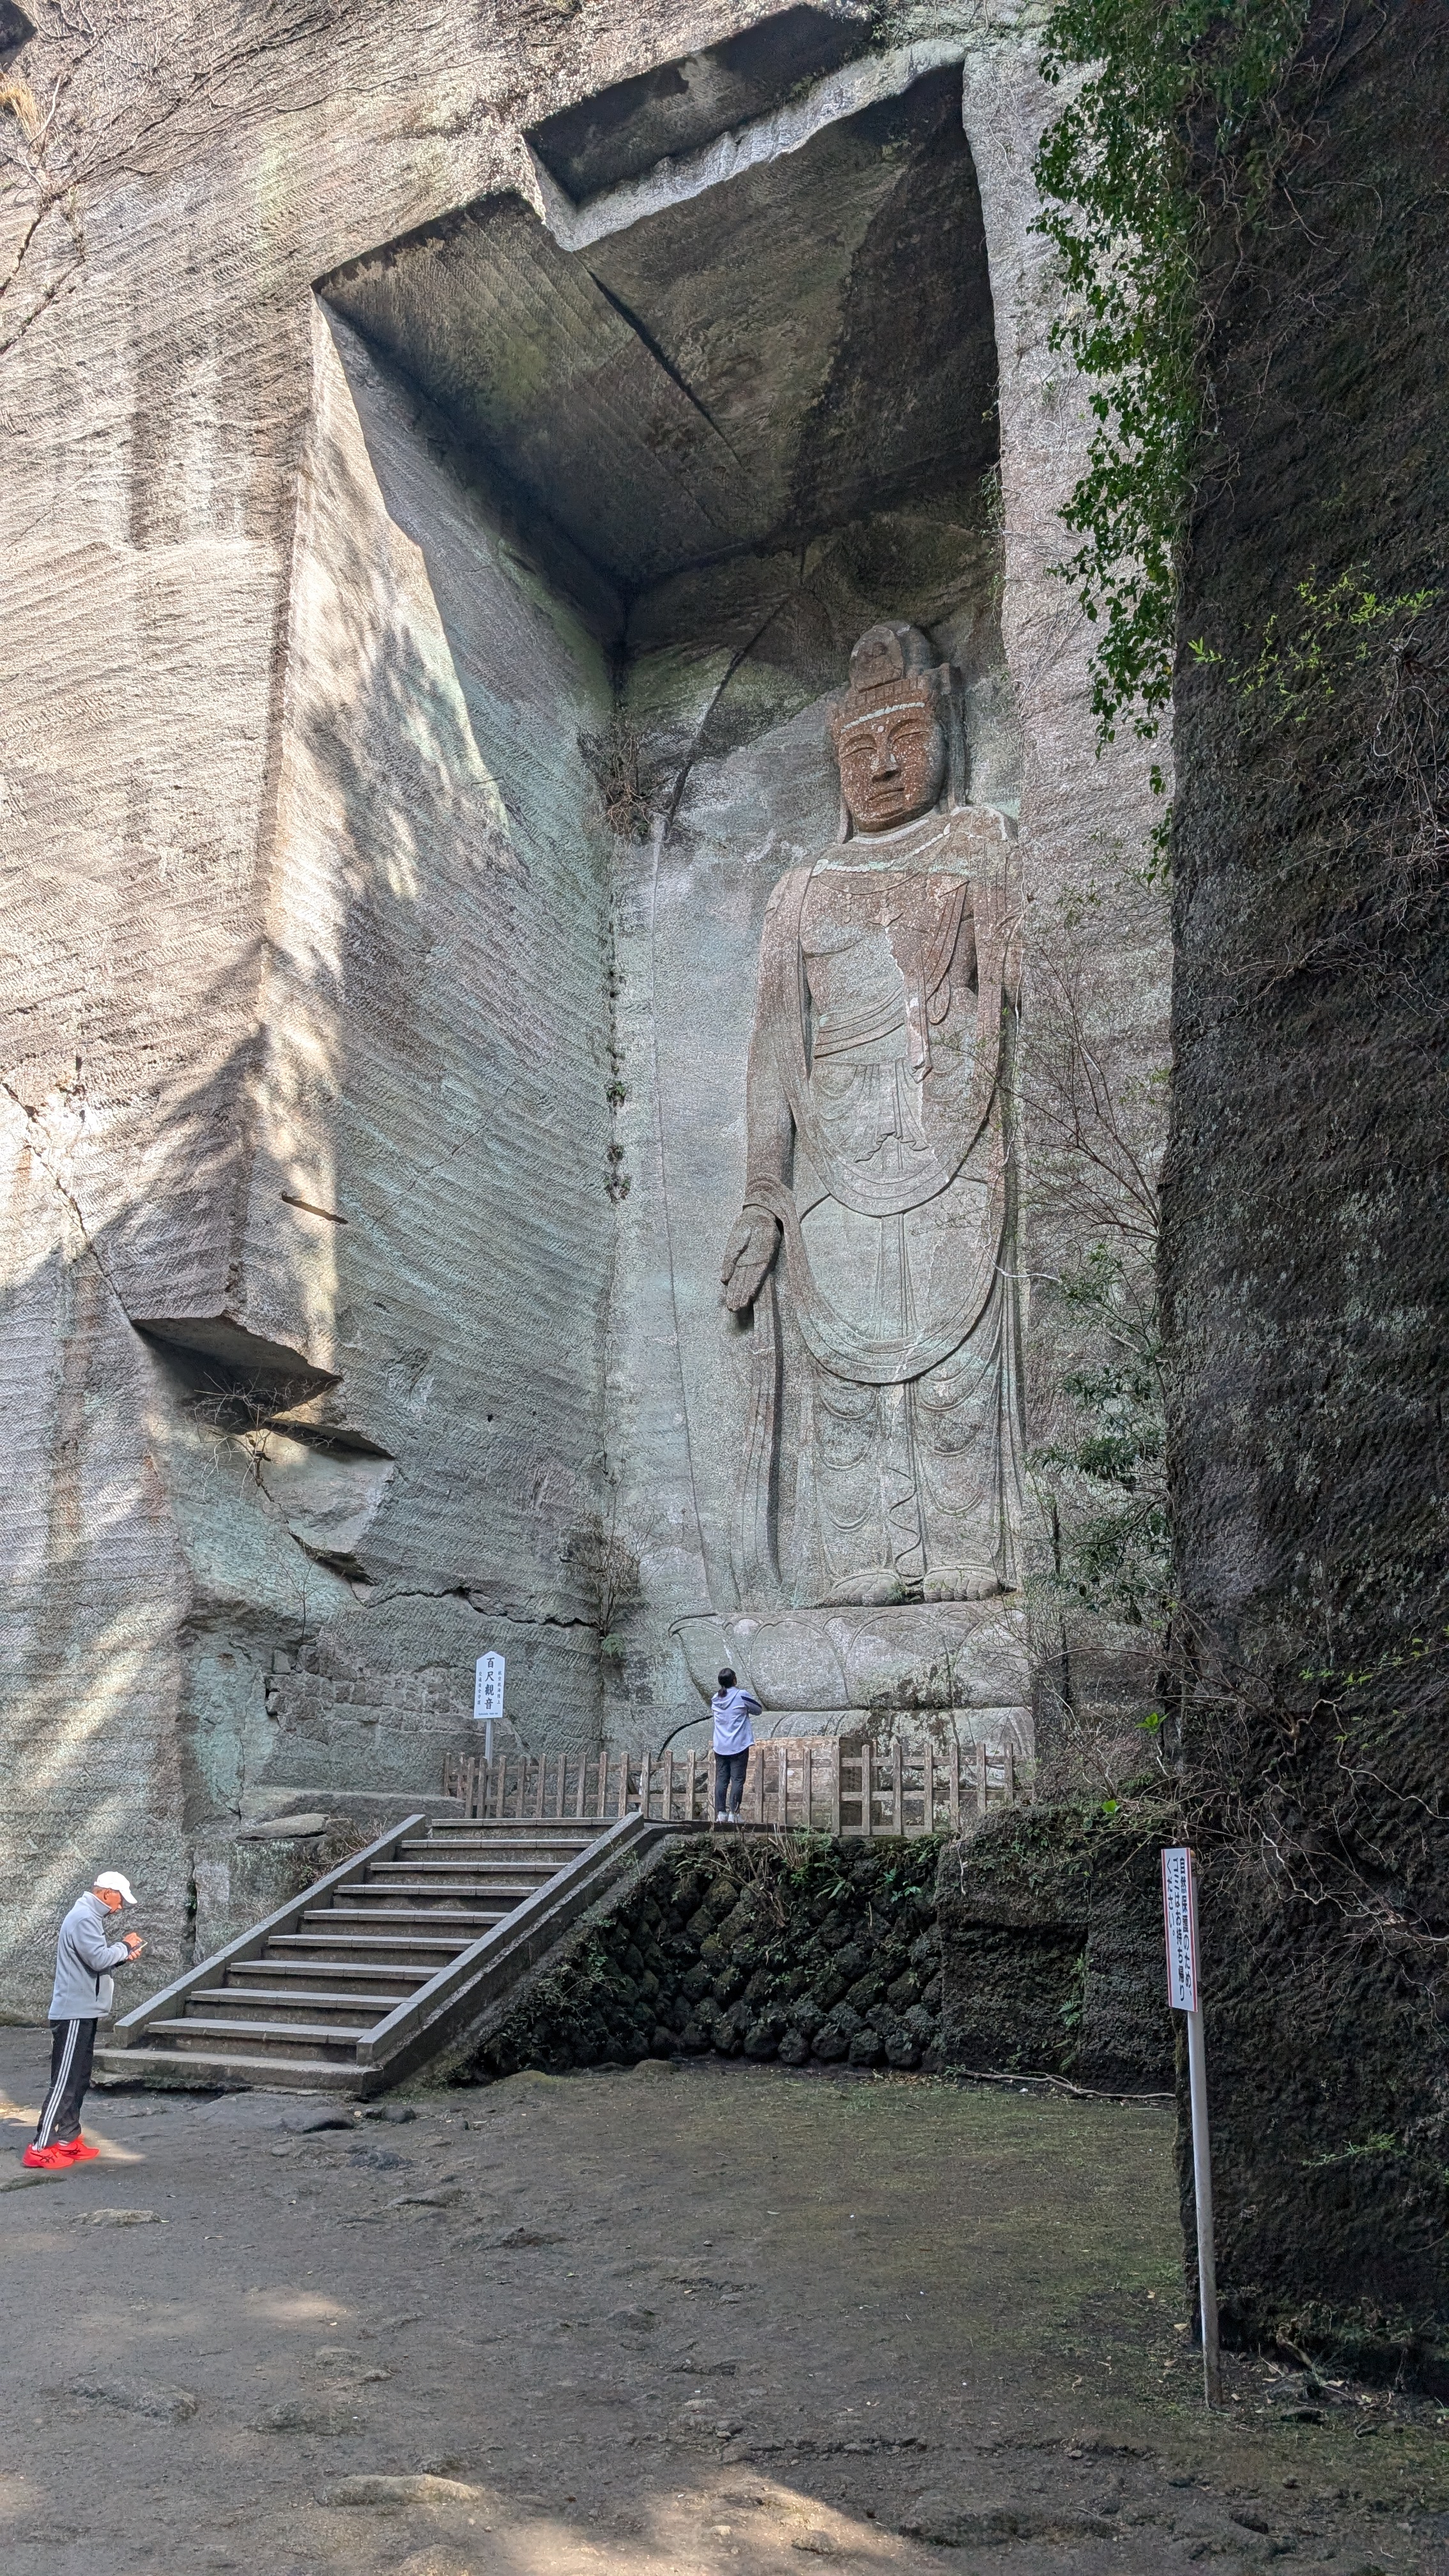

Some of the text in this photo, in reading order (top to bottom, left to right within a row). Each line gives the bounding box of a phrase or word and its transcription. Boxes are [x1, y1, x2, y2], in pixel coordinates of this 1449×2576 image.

[484, 1657, 495, 1710] 百尺観音
[1167, 1857, 1176, 1936] ください。
[1172, 1857, 1184, 2001] ゴミはお持ち帰り
[1179, 1856, 1192, 1996] 自然保護のため、
